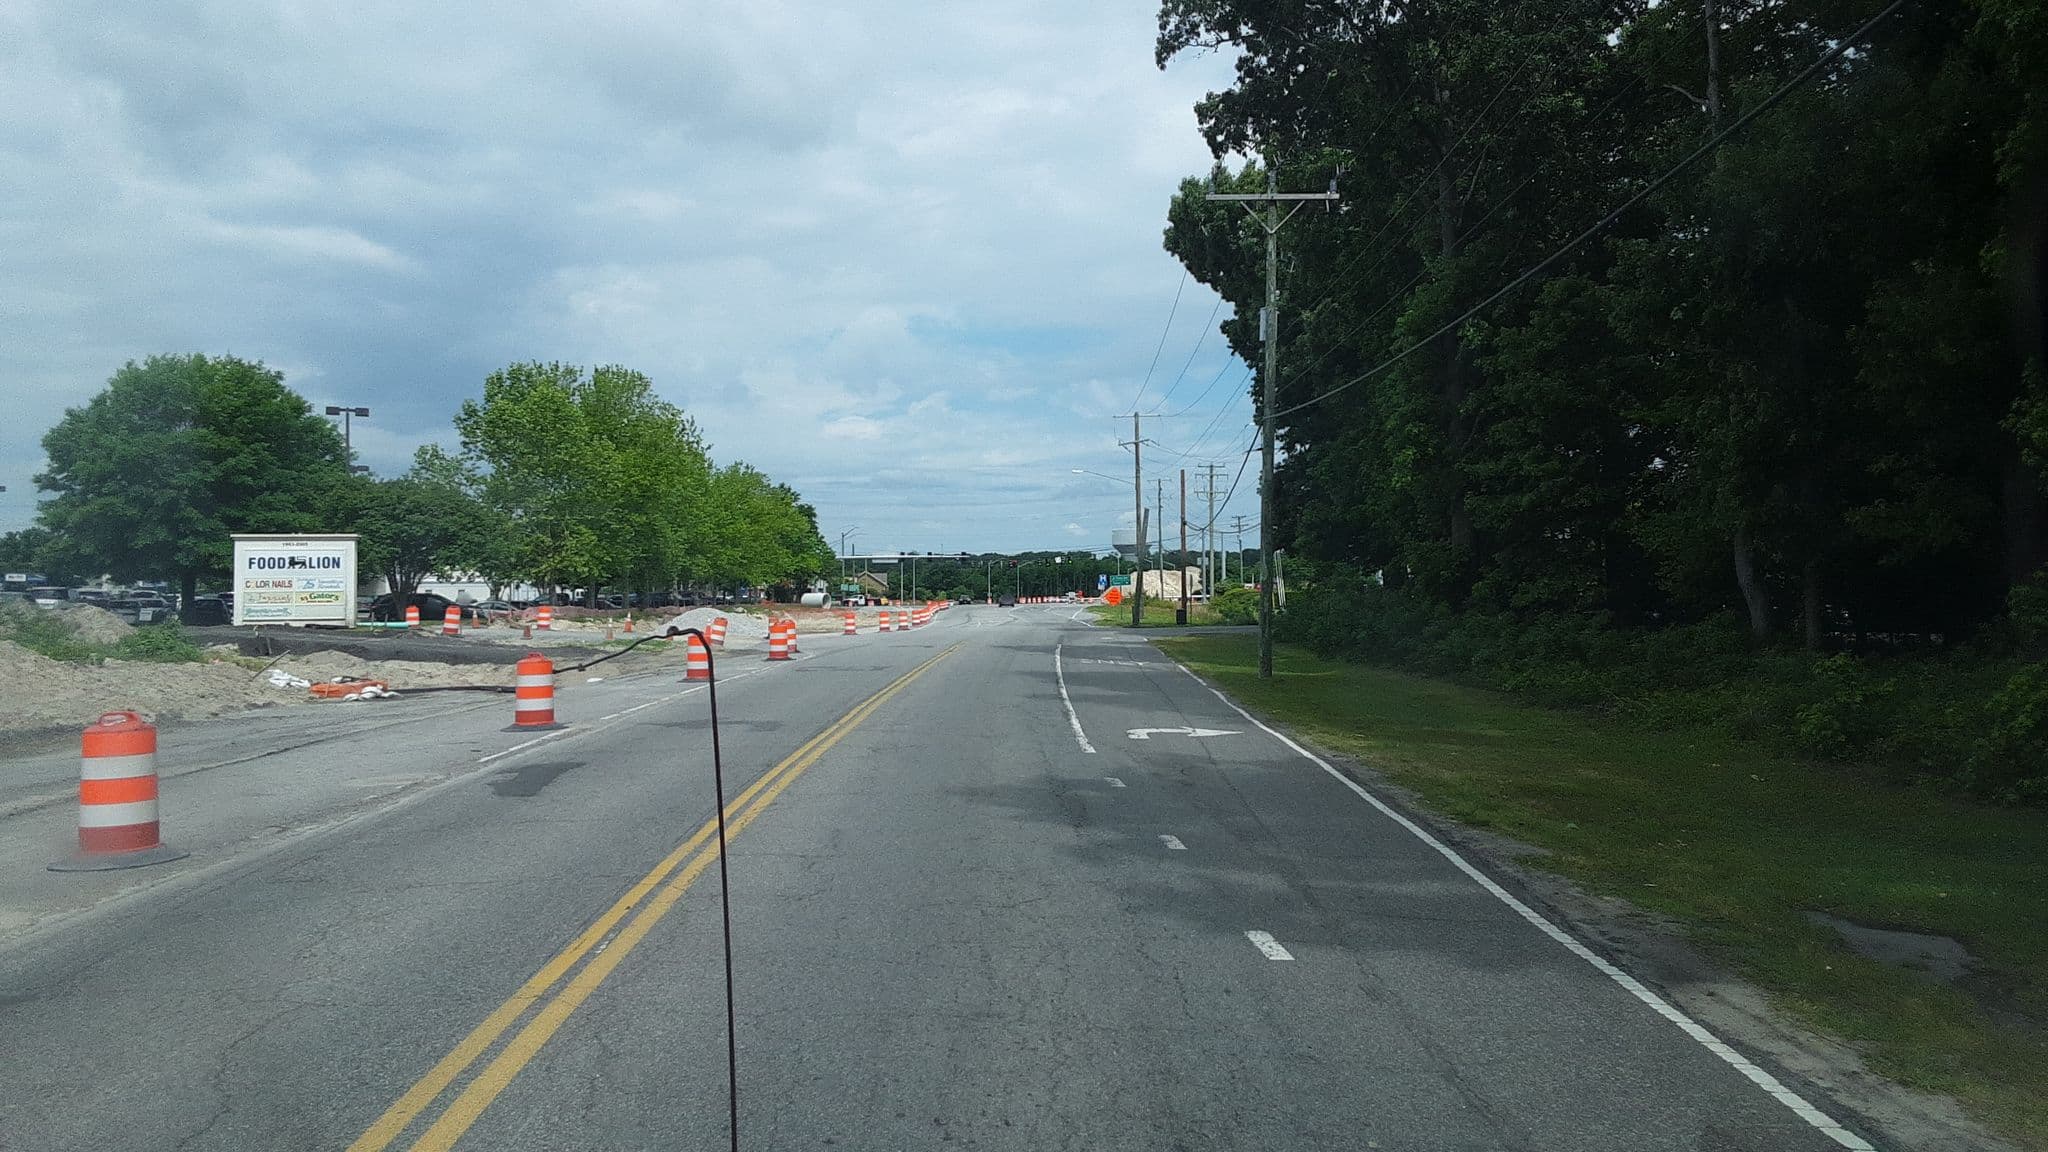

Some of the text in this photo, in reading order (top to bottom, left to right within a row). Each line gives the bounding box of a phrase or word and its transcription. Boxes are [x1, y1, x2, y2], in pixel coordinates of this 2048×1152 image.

[249, 557, 340, 569] FOOD LION
[272, 580, 293, 588] NAILS
